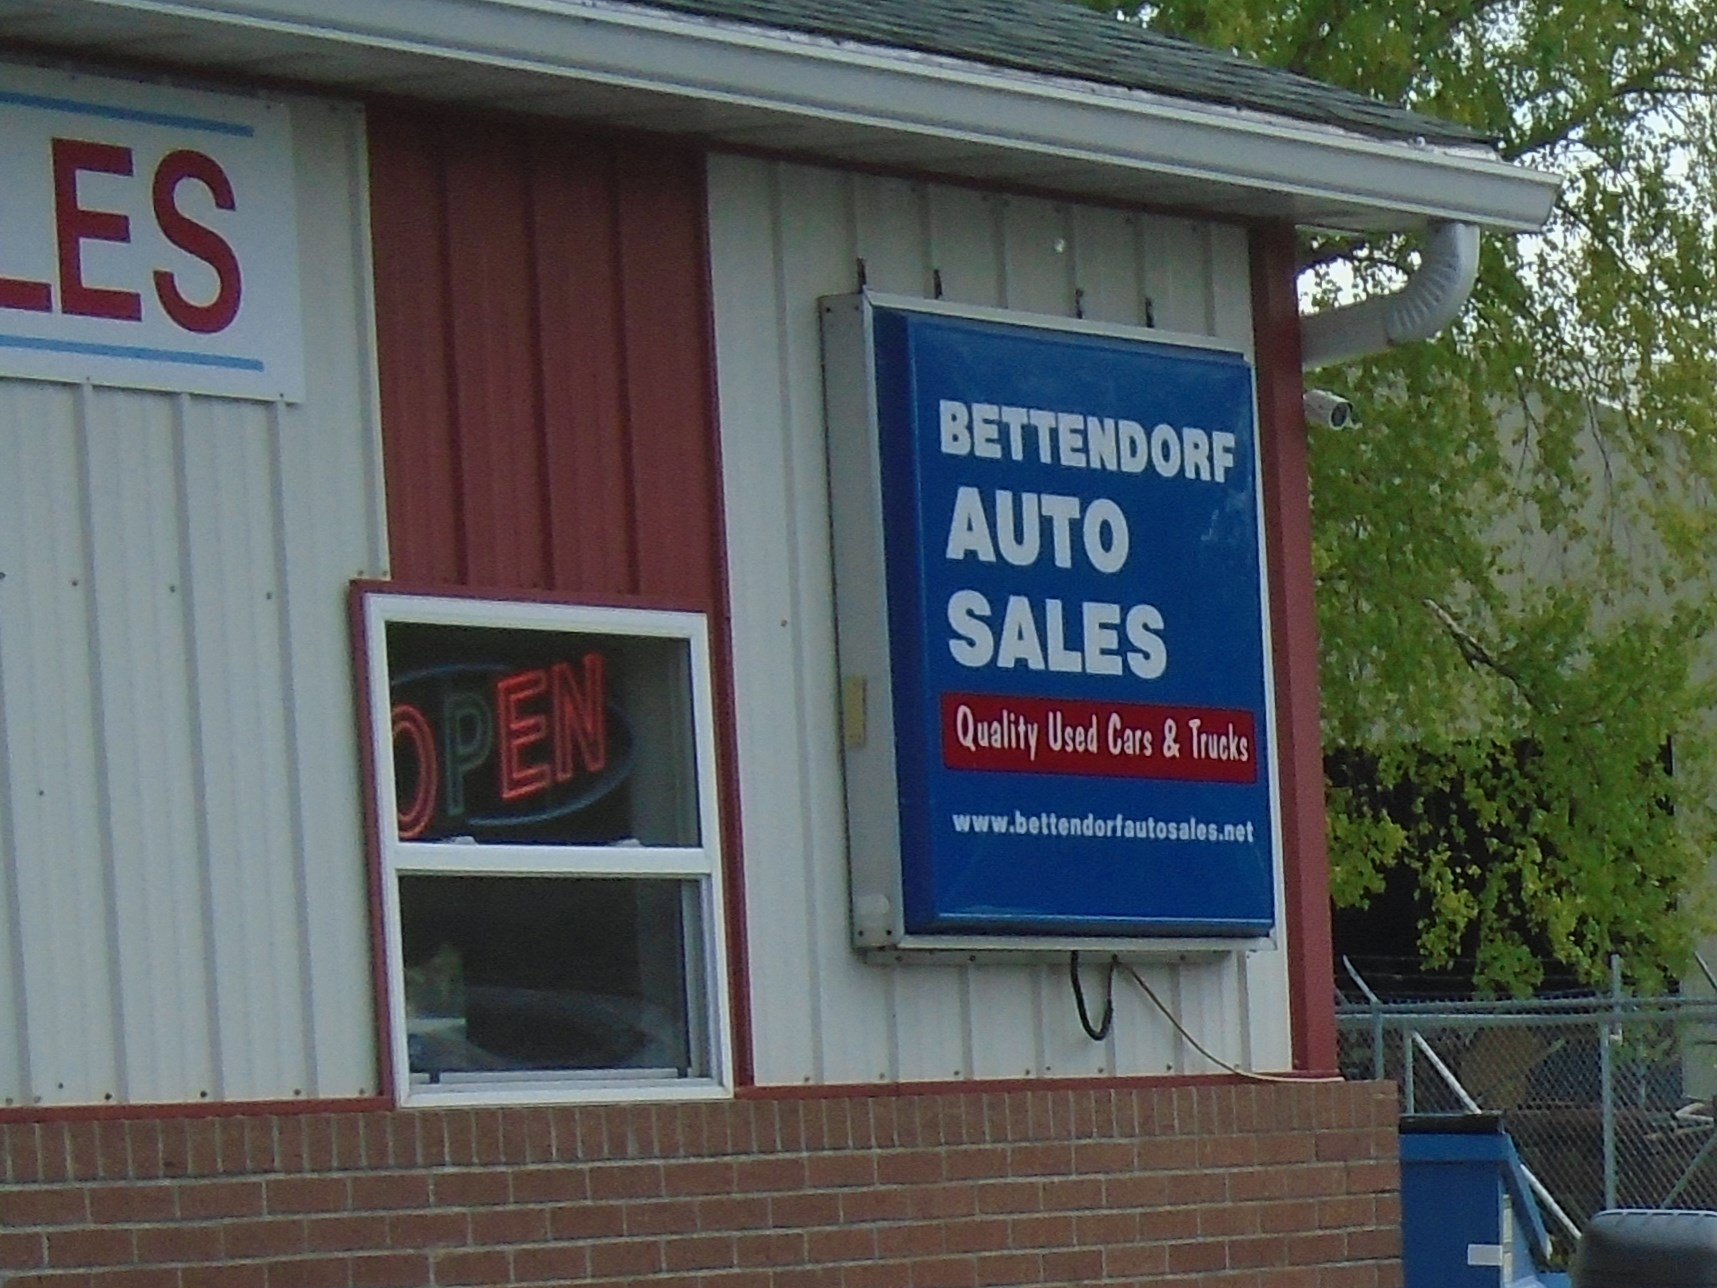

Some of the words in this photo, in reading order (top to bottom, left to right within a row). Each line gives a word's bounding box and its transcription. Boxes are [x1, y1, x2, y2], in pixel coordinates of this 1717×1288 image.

[938, 399, 1236, 483] BETTENDORF
[945, 486, 1130, 574] AUTO
[946, 588, 1167, 680] SALES
[391, 652, 606, 839] OPEN
[956, 704, 1038, 761] Quality
[1048, 711, 1098, 754] Used
[1108, 713, 1152, 757] Cars
[1163, 718, 1180, 759] &
[1188, 719, 1249, 762] Trucks
[952, 810, 1255, 843] www.bettendorfautosales.net
